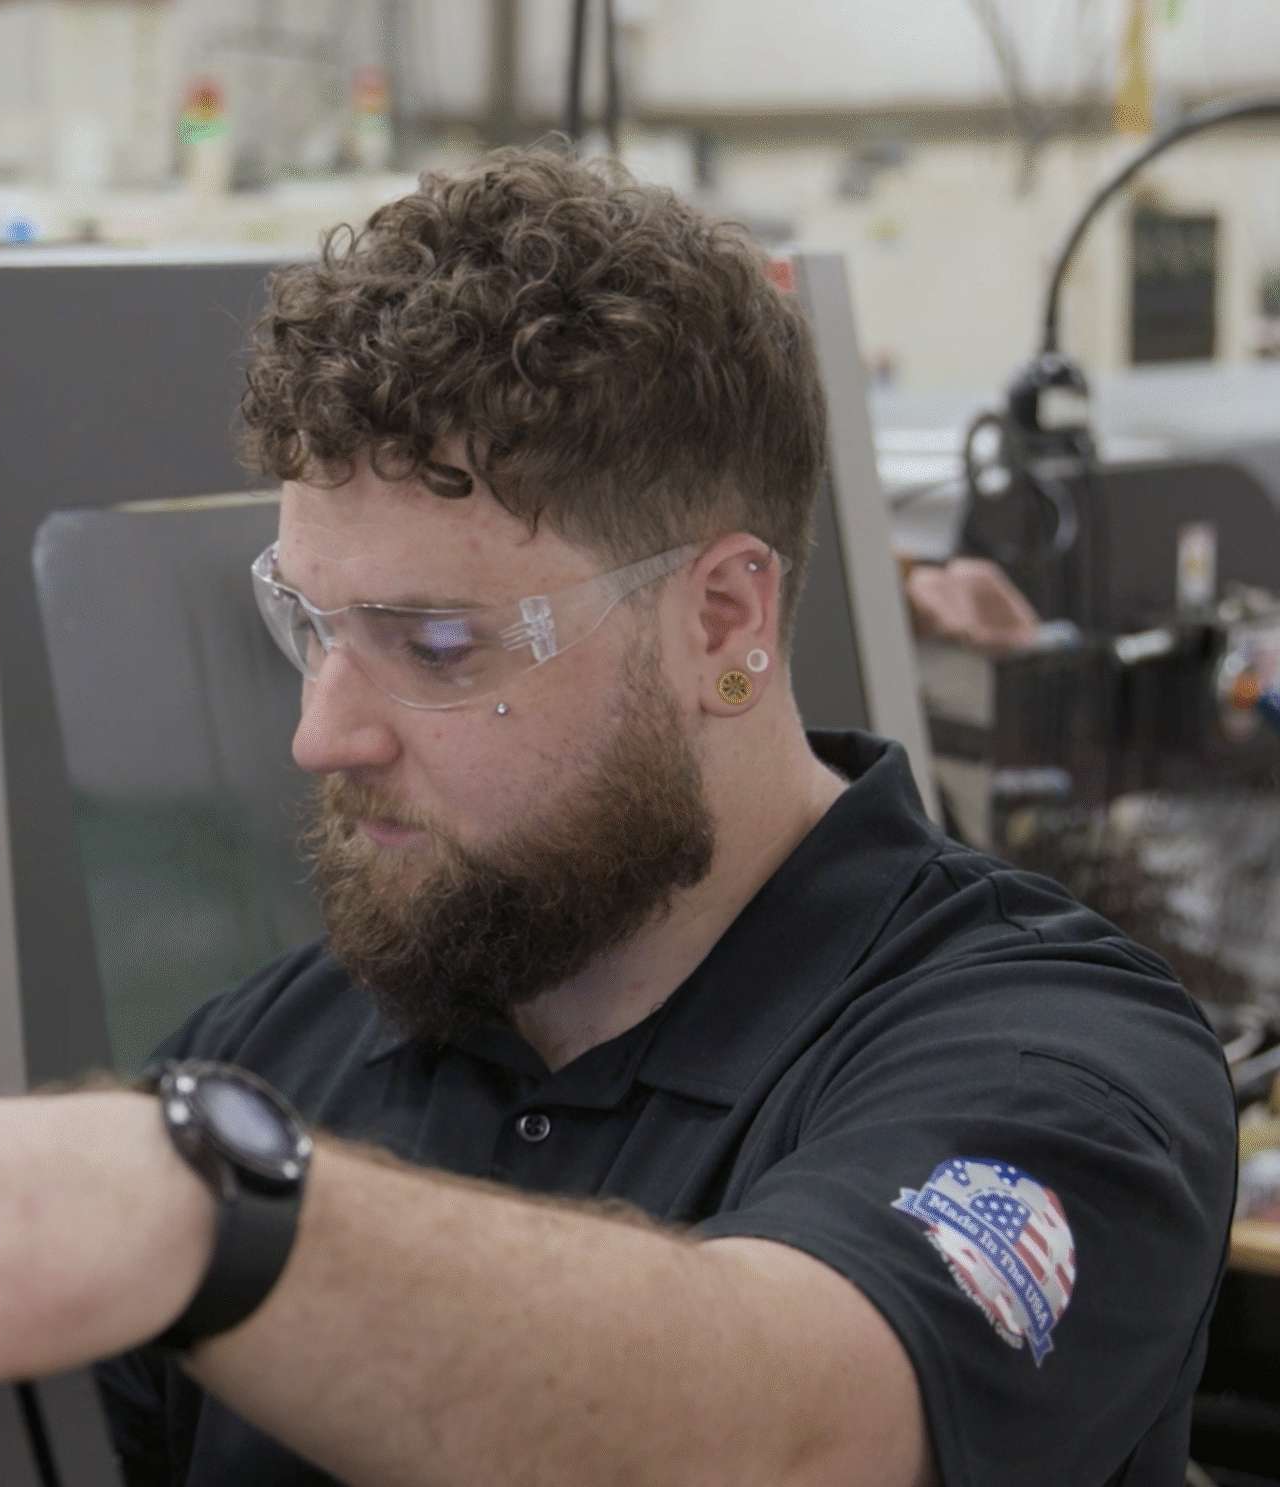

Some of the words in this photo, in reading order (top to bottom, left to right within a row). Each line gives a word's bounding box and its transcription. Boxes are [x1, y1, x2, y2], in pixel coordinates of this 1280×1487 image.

[927, 1193, 980, 1236] Made
[980, 1229, 999, 1255] In
[998, 1249, 1027, 1287] The
[1025, 1284, 1049, 1330] USA
